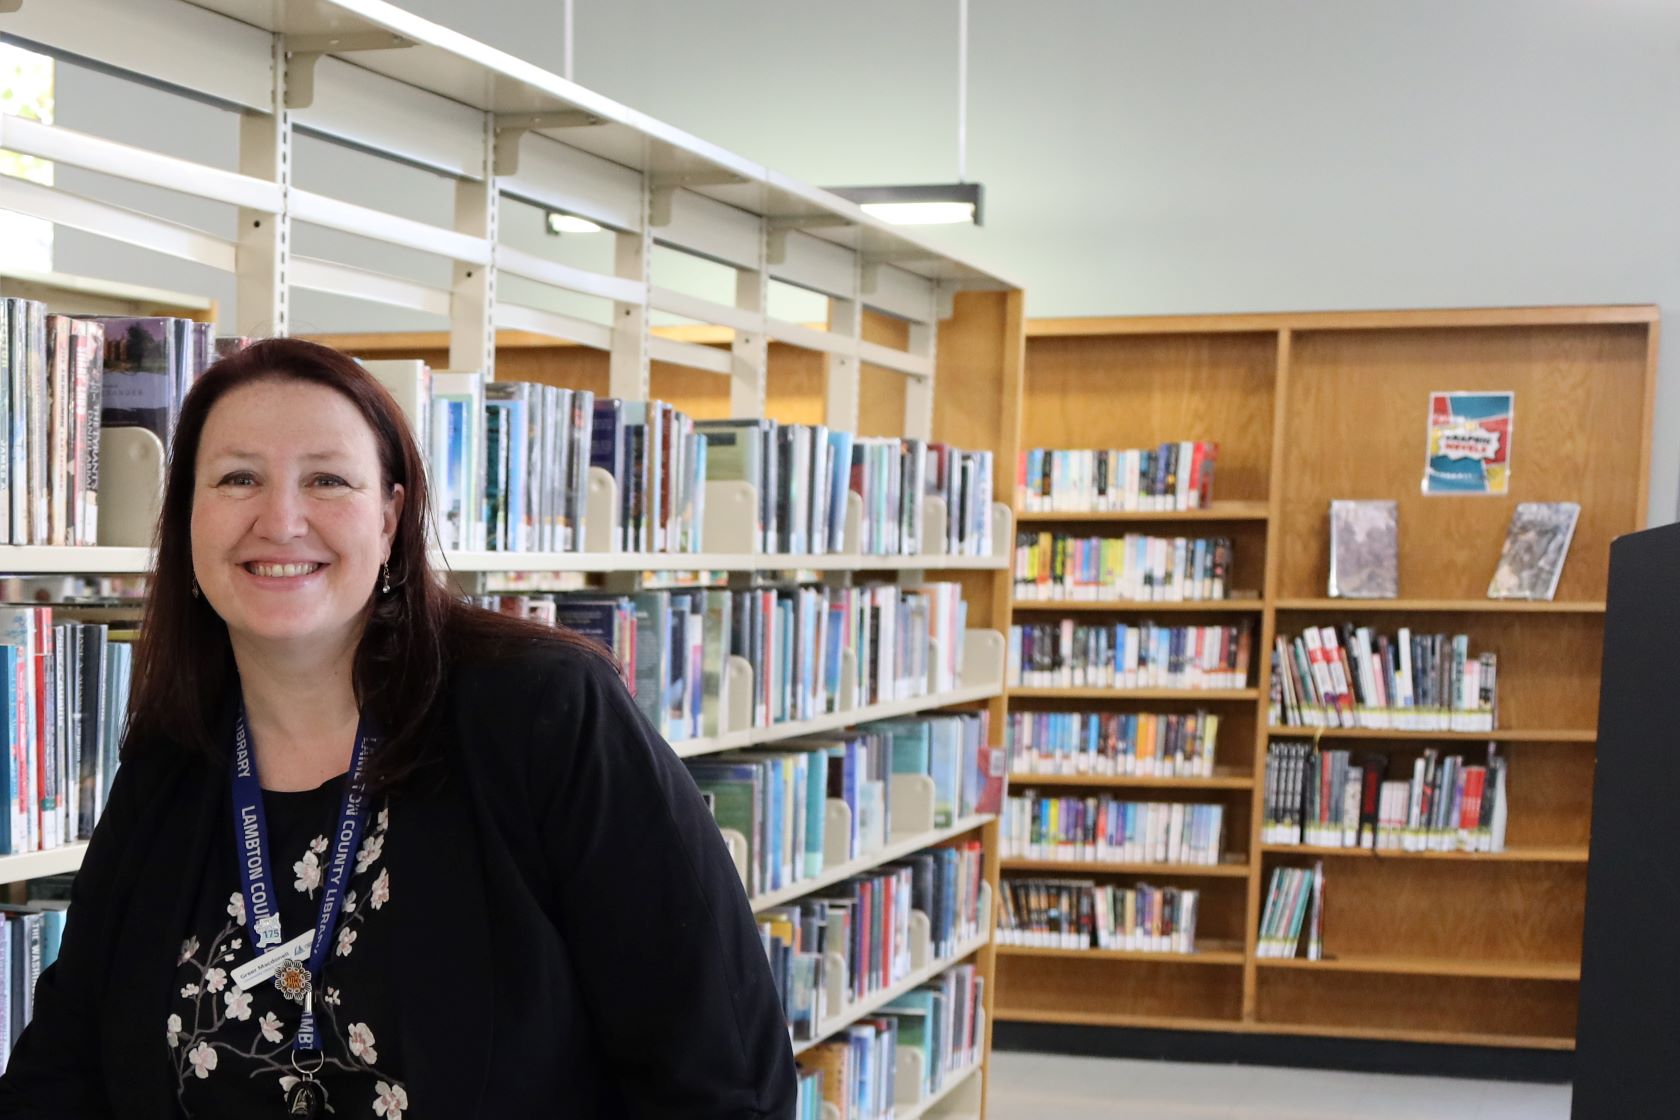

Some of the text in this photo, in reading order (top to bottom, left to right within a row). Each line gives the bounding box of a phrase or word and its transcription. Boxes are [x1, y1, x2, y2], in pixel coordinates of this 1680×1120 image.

[241, 804, 264, 881] LAMBTON
[331, 820, 356, 885] COUNTY
[31, 923, 40, 941] THE
[263, 928, 280, 939] 175
